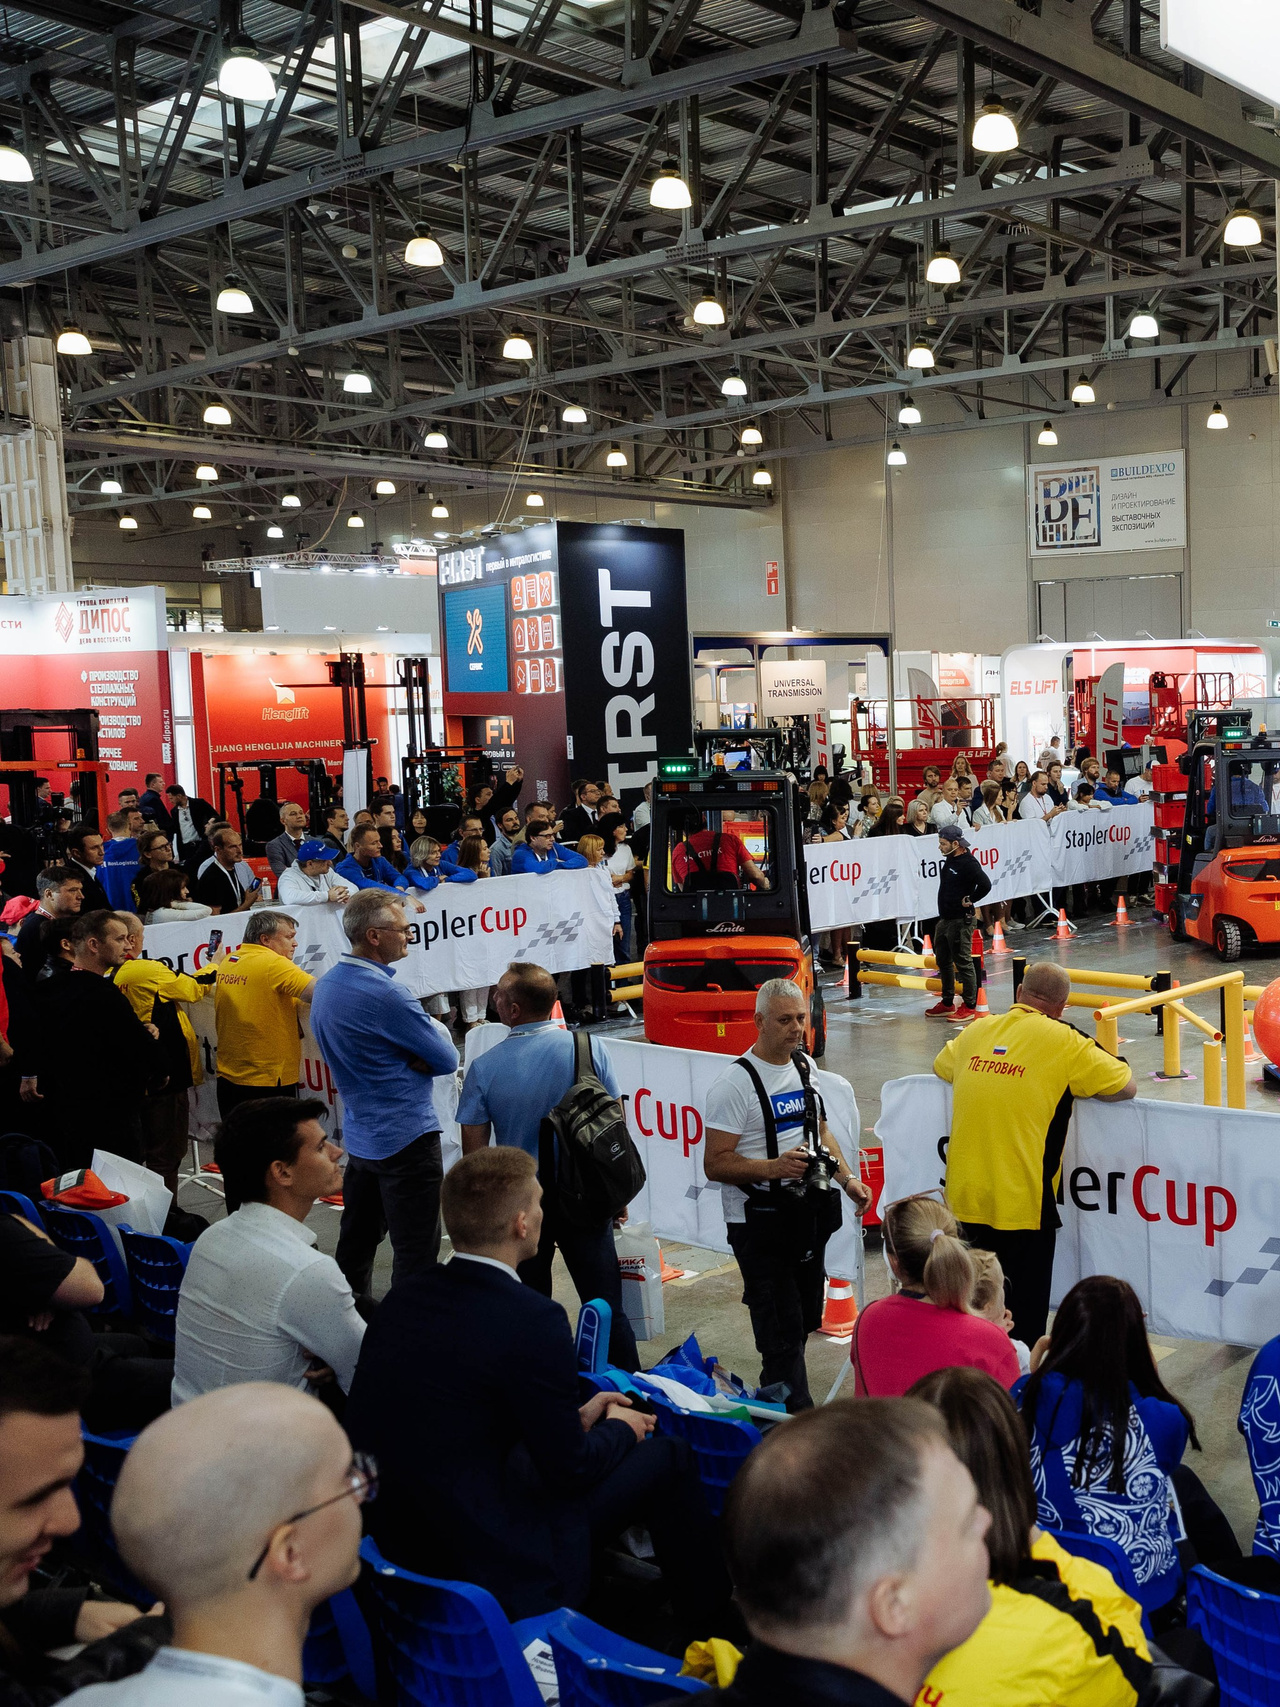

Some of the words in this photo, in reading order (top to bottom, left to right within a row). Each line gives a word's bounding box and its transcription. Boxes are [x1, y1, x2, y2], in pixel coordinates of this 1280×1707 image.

[1118, 463, 1176, 477] BUILDEXPO
[1111, 492, 1137, 501] ДИЗАЙН
[1117, 498, 1176, 509] ПРОЕКТИРОВАНИЕ
[1111, 512, 1161, 523] ВЫСТАВОЧНЫХ
[1111, 522, 1155, 532] ЭКСПОЗИЦИЙ
[438, 545, 486, 586] FIRST
[78, 607, 131, 634] ДИПОС
[89, 670, 139, 682] ПРОИЗВОДСТВО
[89, 683, 135, 694] СТЕЛЛАЖНЫХ
[773, 678, 815, 688] UNIVERSAL
[1010, 680, 1032, 696] ELS
[1034, 679, 1059, 695] LIFT
[767, 687, 822, 698] TRANSMISSION
[90, 694, 137, 708] КОНСТРУКЦИЙ
[261, 707, 310, 722] Henglift
[1102, 692, 1119, 747] LIFT
[244, 741, 294, 751] HENGLIJIA
[109, 760, 139, 772] КОВАНИЕ
[1065, 824, 1131, 852] StaplerCup
[754, 844, 760, 853] 2
[706, 921, 746, 933] Linde
